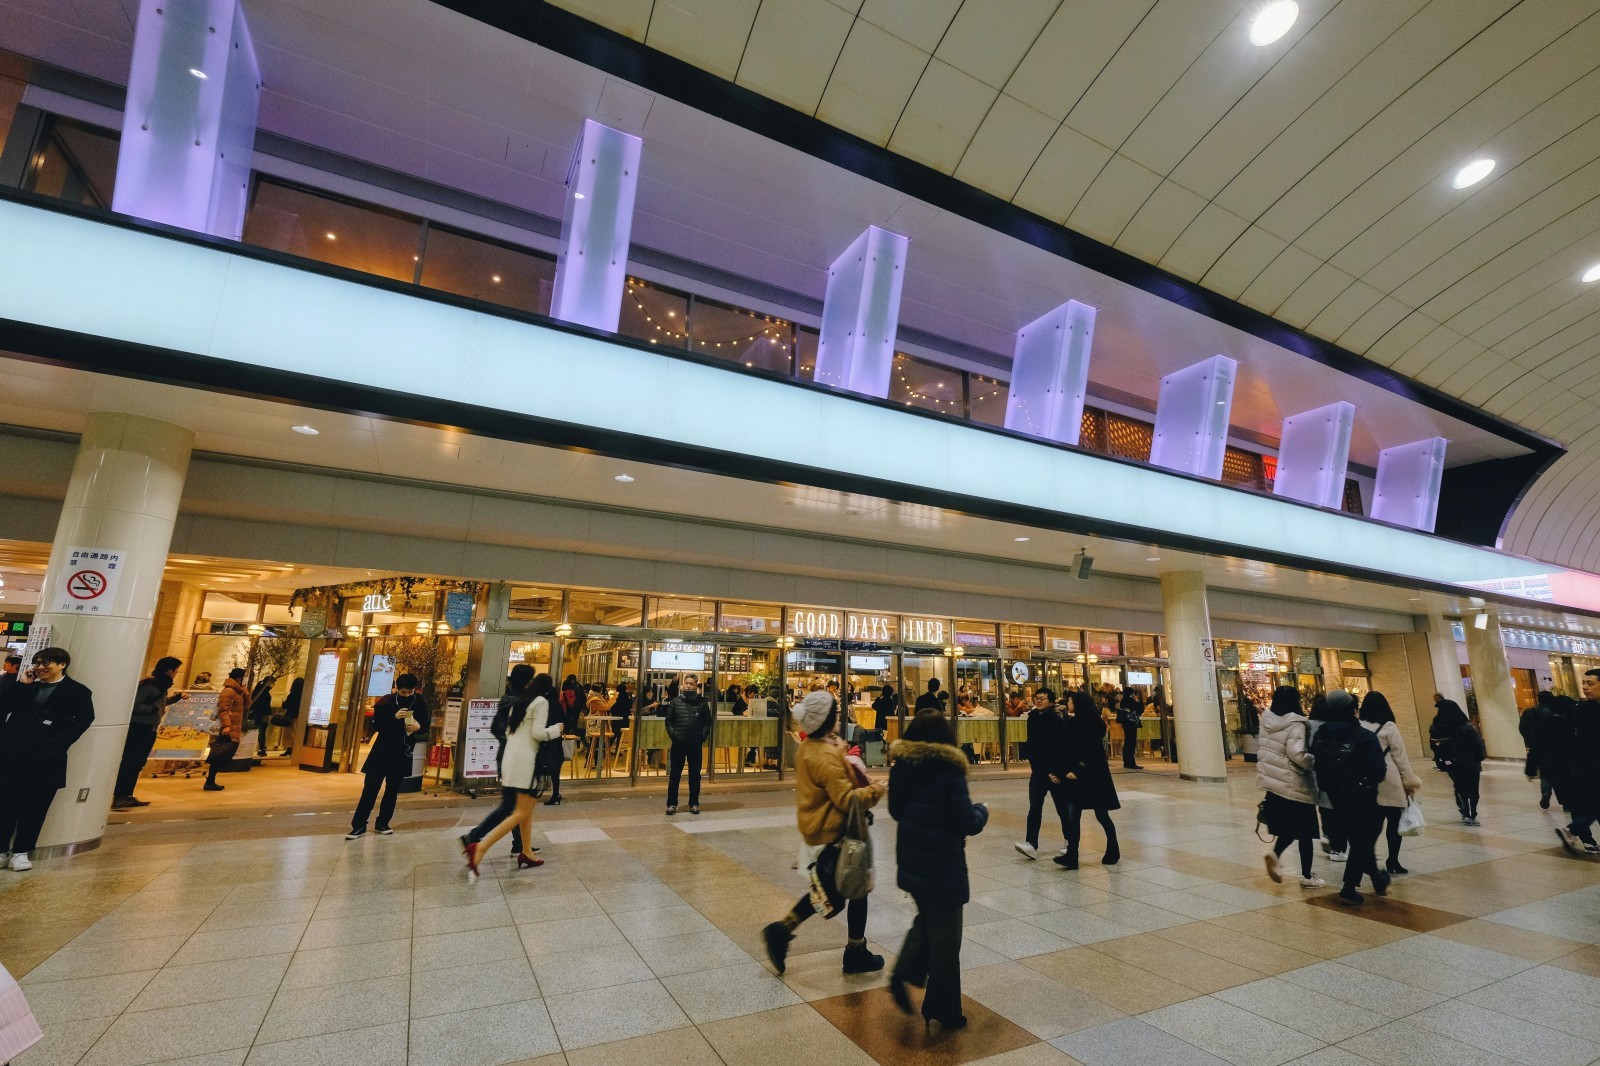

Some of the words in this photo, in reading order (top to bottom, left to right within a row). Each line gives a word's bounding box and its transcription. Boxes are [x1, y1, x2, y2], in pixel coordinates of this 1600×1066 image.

[72, 551, 119, 562] 自由通路内
[794, 611, 839, 636] GOOD
[849, 615, 888, 640] DAYS
